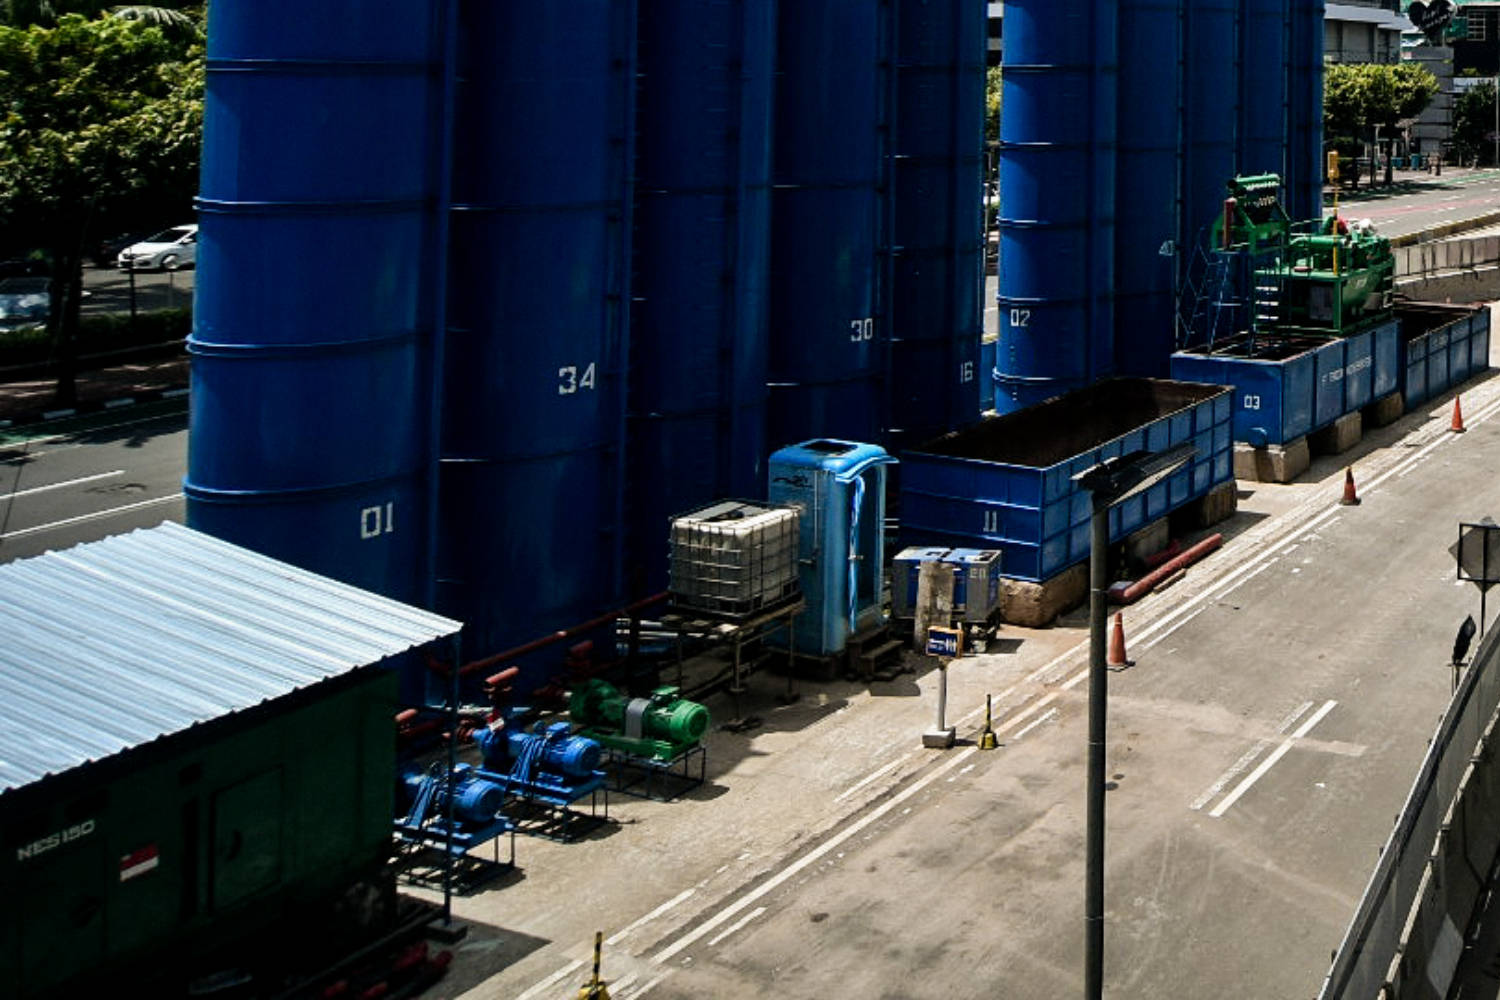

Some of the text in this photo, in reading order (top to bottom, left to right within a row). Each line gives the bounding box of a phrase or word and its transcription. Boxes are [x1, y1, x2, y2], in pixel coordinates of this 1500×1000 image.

[851, 318, 873, 342] 30
[1010, 309, 1030, 327] 02
[558, 362, 596, 395] 34
[961, 361, 973, 384] 16
[1244, 394, 1260, 410] 03
[360, 502, 394, 539] 01
[16, 833, 61, 861] NES
